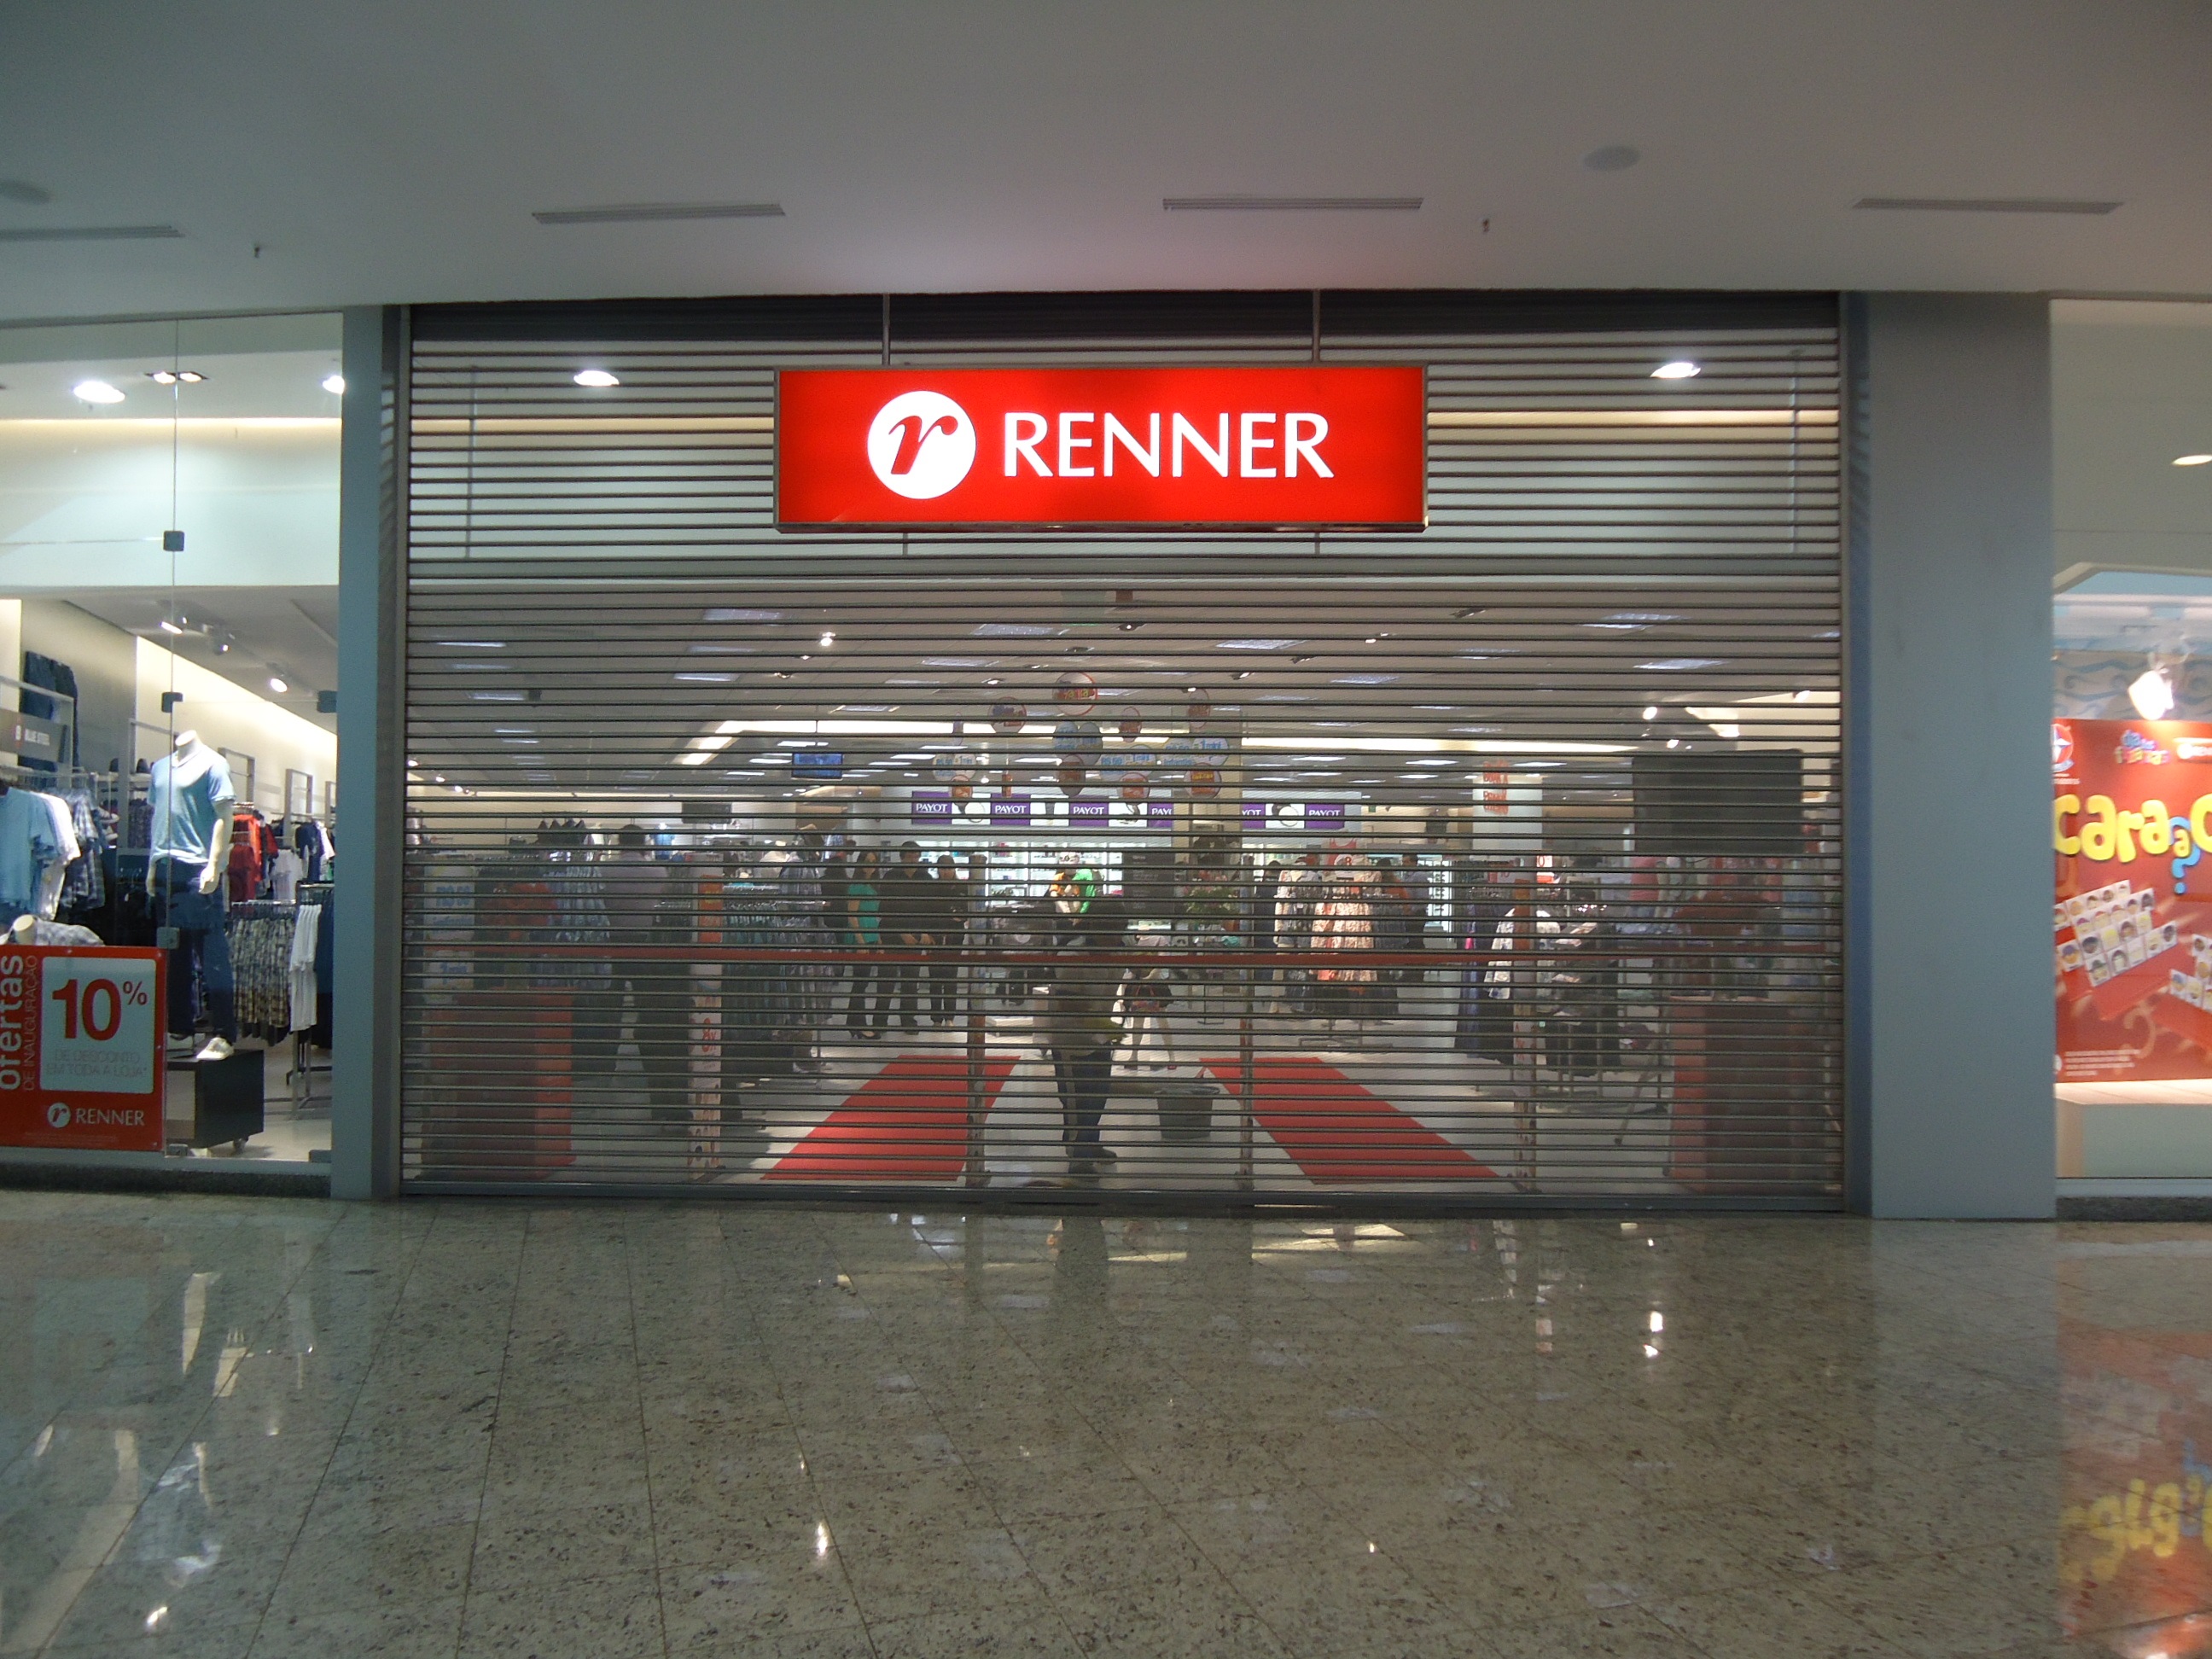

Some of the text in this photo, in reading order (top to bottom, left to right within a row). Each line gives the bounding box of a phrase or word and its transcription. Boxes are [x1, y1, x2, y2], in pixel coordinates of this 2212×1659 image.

[1004, 411, 1335, 479] RENNER
[916, 803, 947, 813] PAYOT
[994, 805, 1027, 814] PAYOT
[1073, 806, 1105, 815] PAYOT
[52, 978, 148, 1041] 10%
[0, 955, 24, 1090] ofertas
[22, 1069, 36, 1091] DE
[75, 1108, 145, 1126] RENNER
